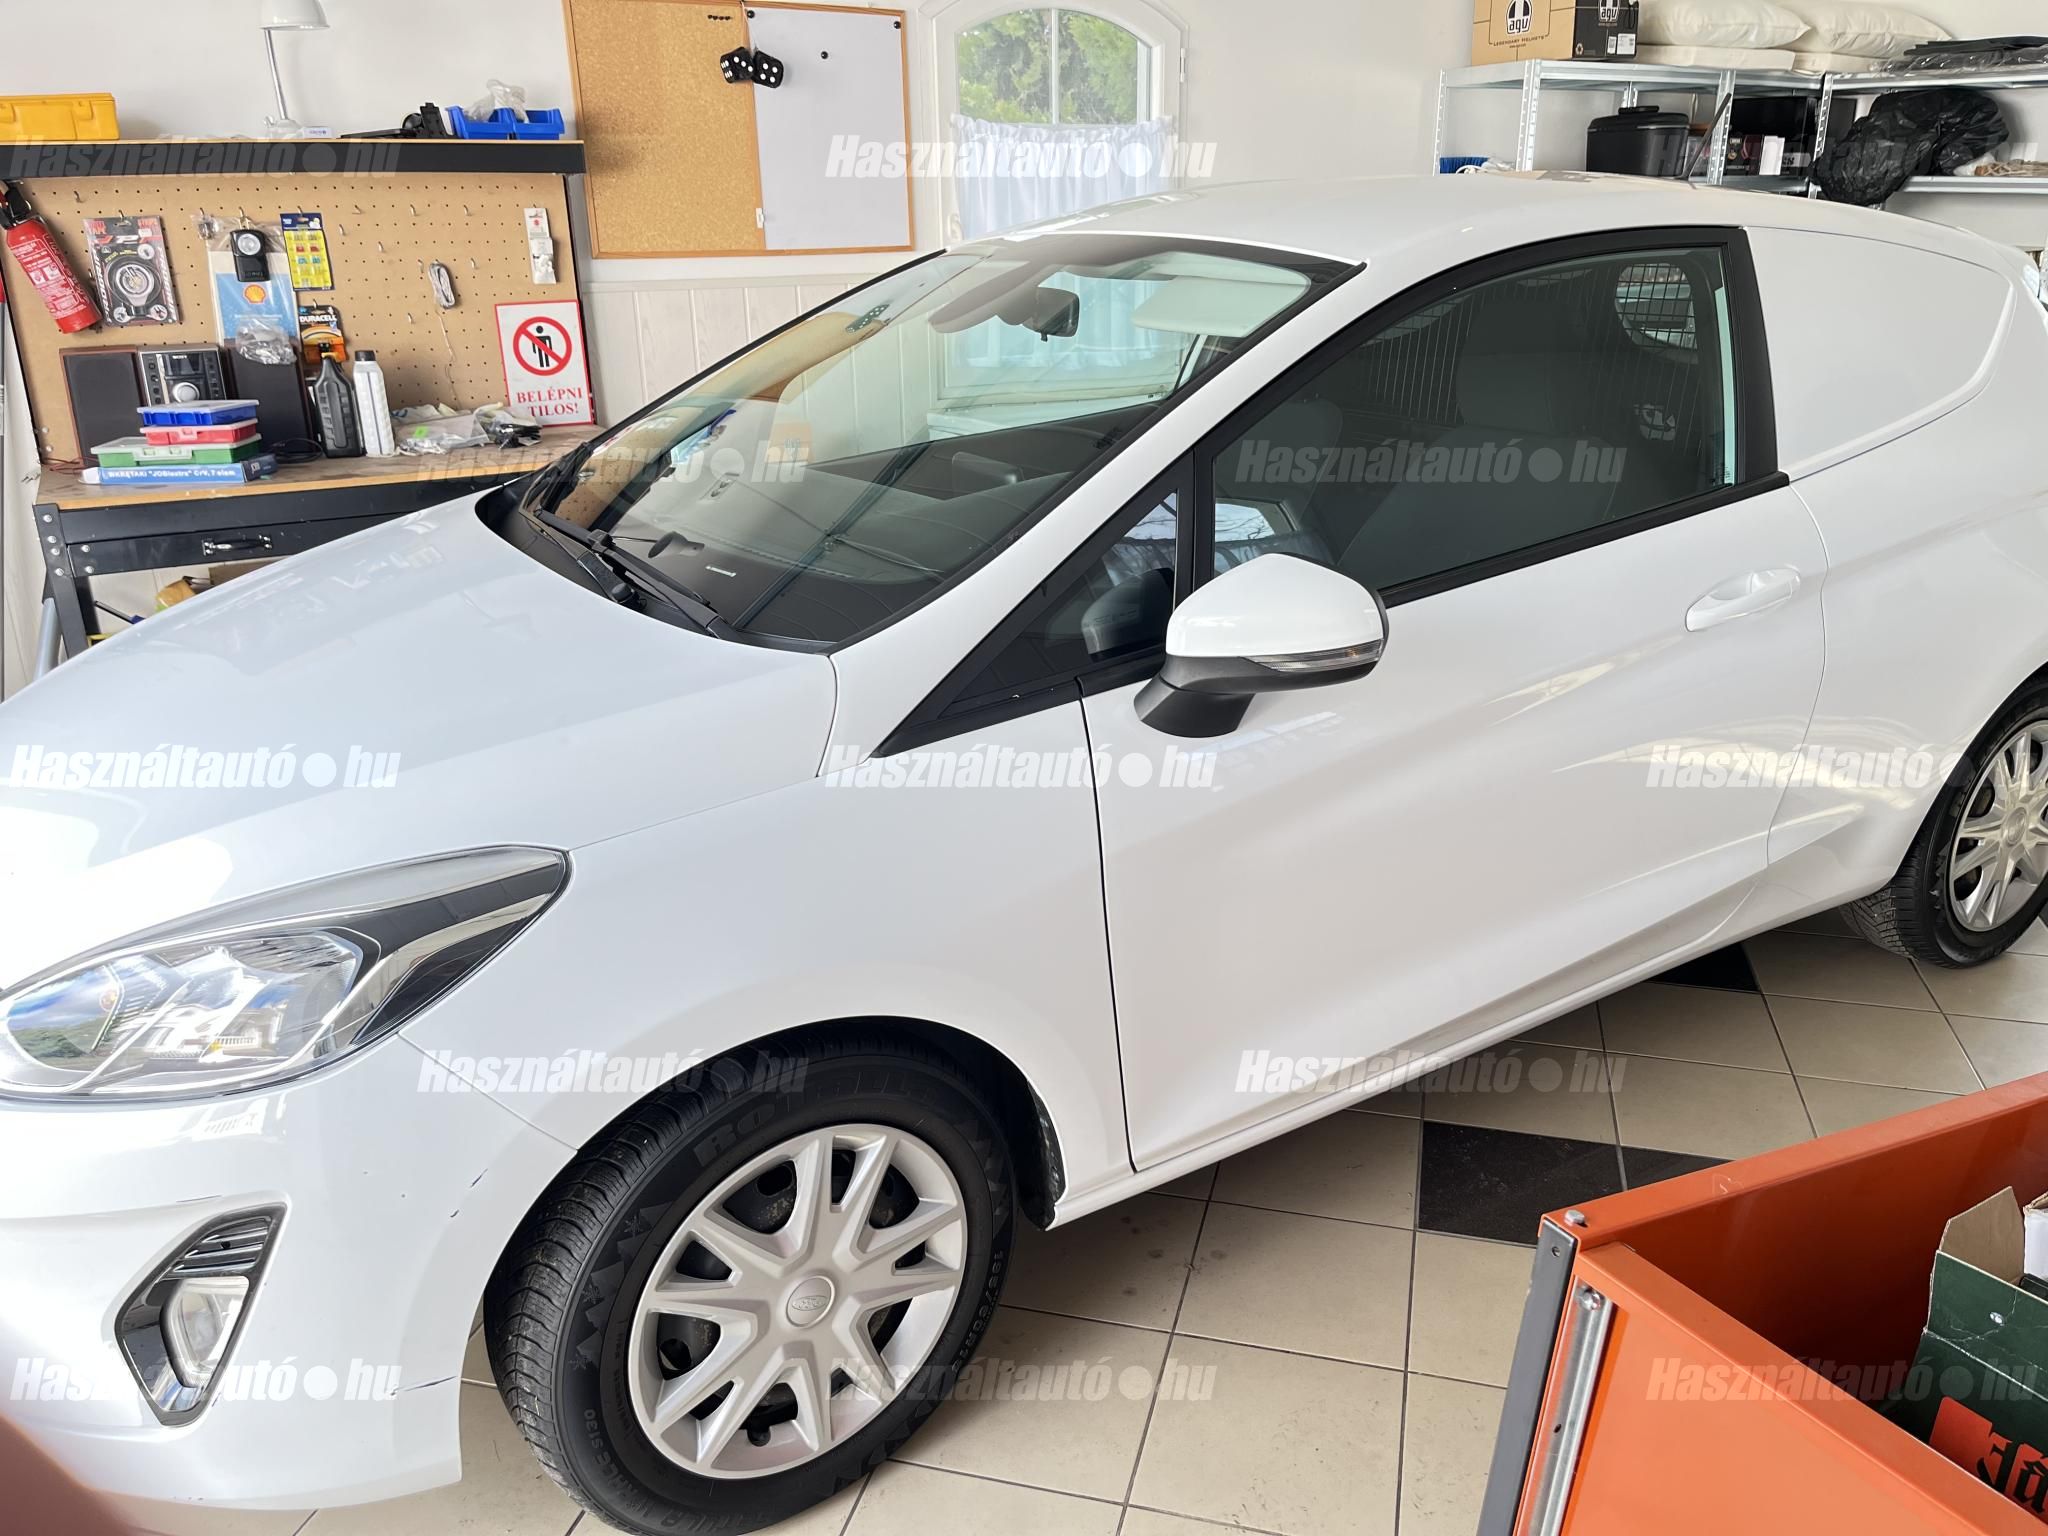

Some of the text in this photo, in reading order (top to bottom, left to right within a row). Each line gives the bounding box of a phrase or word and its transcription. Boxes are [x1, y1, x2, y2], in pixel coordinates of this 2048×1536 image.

[299, 314, 337, 322] DURACELL
[517, 386, 582, 404] BELÉPNI
[528, 403, 579, 417] TILOS!
